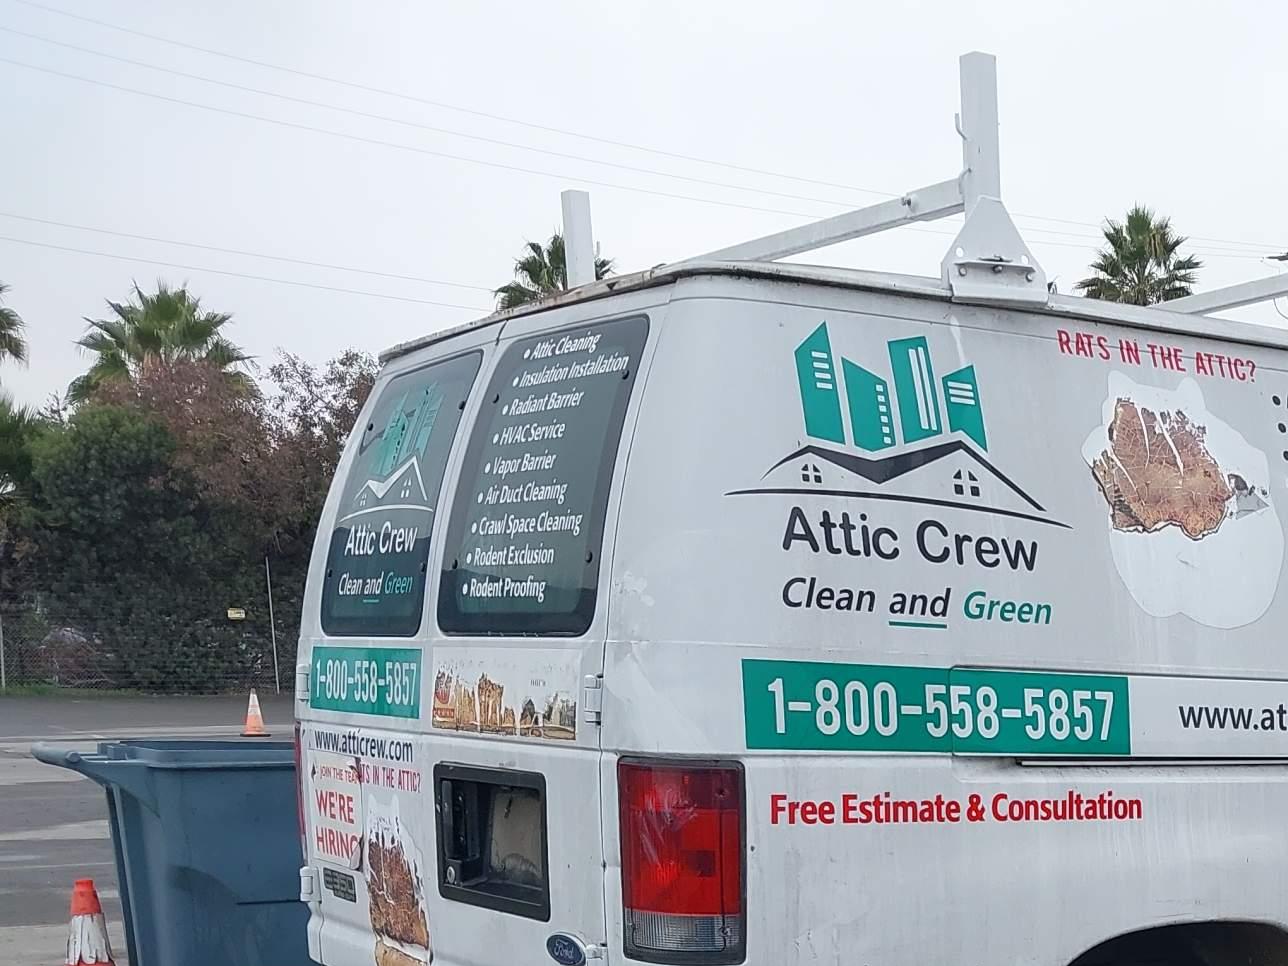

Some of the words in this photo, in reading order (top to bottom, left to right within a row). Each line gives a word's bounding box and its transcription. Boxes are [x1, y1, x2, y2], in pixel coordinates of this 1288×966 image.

[530, 338, 556, 361] Attic
[554, 331, 602, 356] Cleaning
[1057, 330, 1110, 360] RATS
[1118, 339, 1141, 365] IN
[1147, 343, 1186, 372] THE
[1195, 352, 1256, 383] ATTIC?
[519, 363, 568, 388] Insulation
[568, 352, 629, 379] Installation
[509, 392, 548, 416] Radiant
[547, 387, 585, 410] Barrier
[500, 423, 530, 446] HVAC
[528, 419, 566, 441] Service
[493, 457, 521, 480] Vapor
[521, 450, 557, 473] Barrier
[484, 484, 501, 505] Air
[500, 483, 524, 504] Duct
[523, 478, 568, 505] Cleaning
[344, 522, 376, 556] Attic
[379, 521, 418, 554] Crew
[479, 513, 508, 535] Crawl
[506, 514, 536, 540] Space
[537, 509, 583, 536] Cleaning
[782, 506, 900, 561] Attic
[916, 519, 1039, 572] Crew
[474, 546, 506, 566] Rodent
[507, 543, 554, 565] Exclusion
[338, 572, 363, 595] Clean
[363, 571, 384, 595] and
[384, 571, 413, 594] Green
[469, 576, 503, 598] Rodent
[503, 575, 546, 603] Proofing
[782, 577, 876, 613] Clean
[889, 587, 951, 617] and
[963, 590, 1052, 625] Green
[316, 659, 417, 706] 1-800-558-5857
[767, 677, 1115, 741] 1-800-558-5857
[314, 729, 413, 763] www.atticrew.com
[320, 765, 332, 780] JOIN
[332, 766, 343, 781] THE
[372, 765, 380, 786] IN
[382, 766, 395, 789] THE
[397, 768, 422, 794] ATTIC?
[315, 789, 354, 825] WE'RE
[770, 793, 835, 825] Free
[842, 791, 961, 824] Estimate
[966, 793, 986, 823] &
[991, 790, 1143, 821] Consultation
